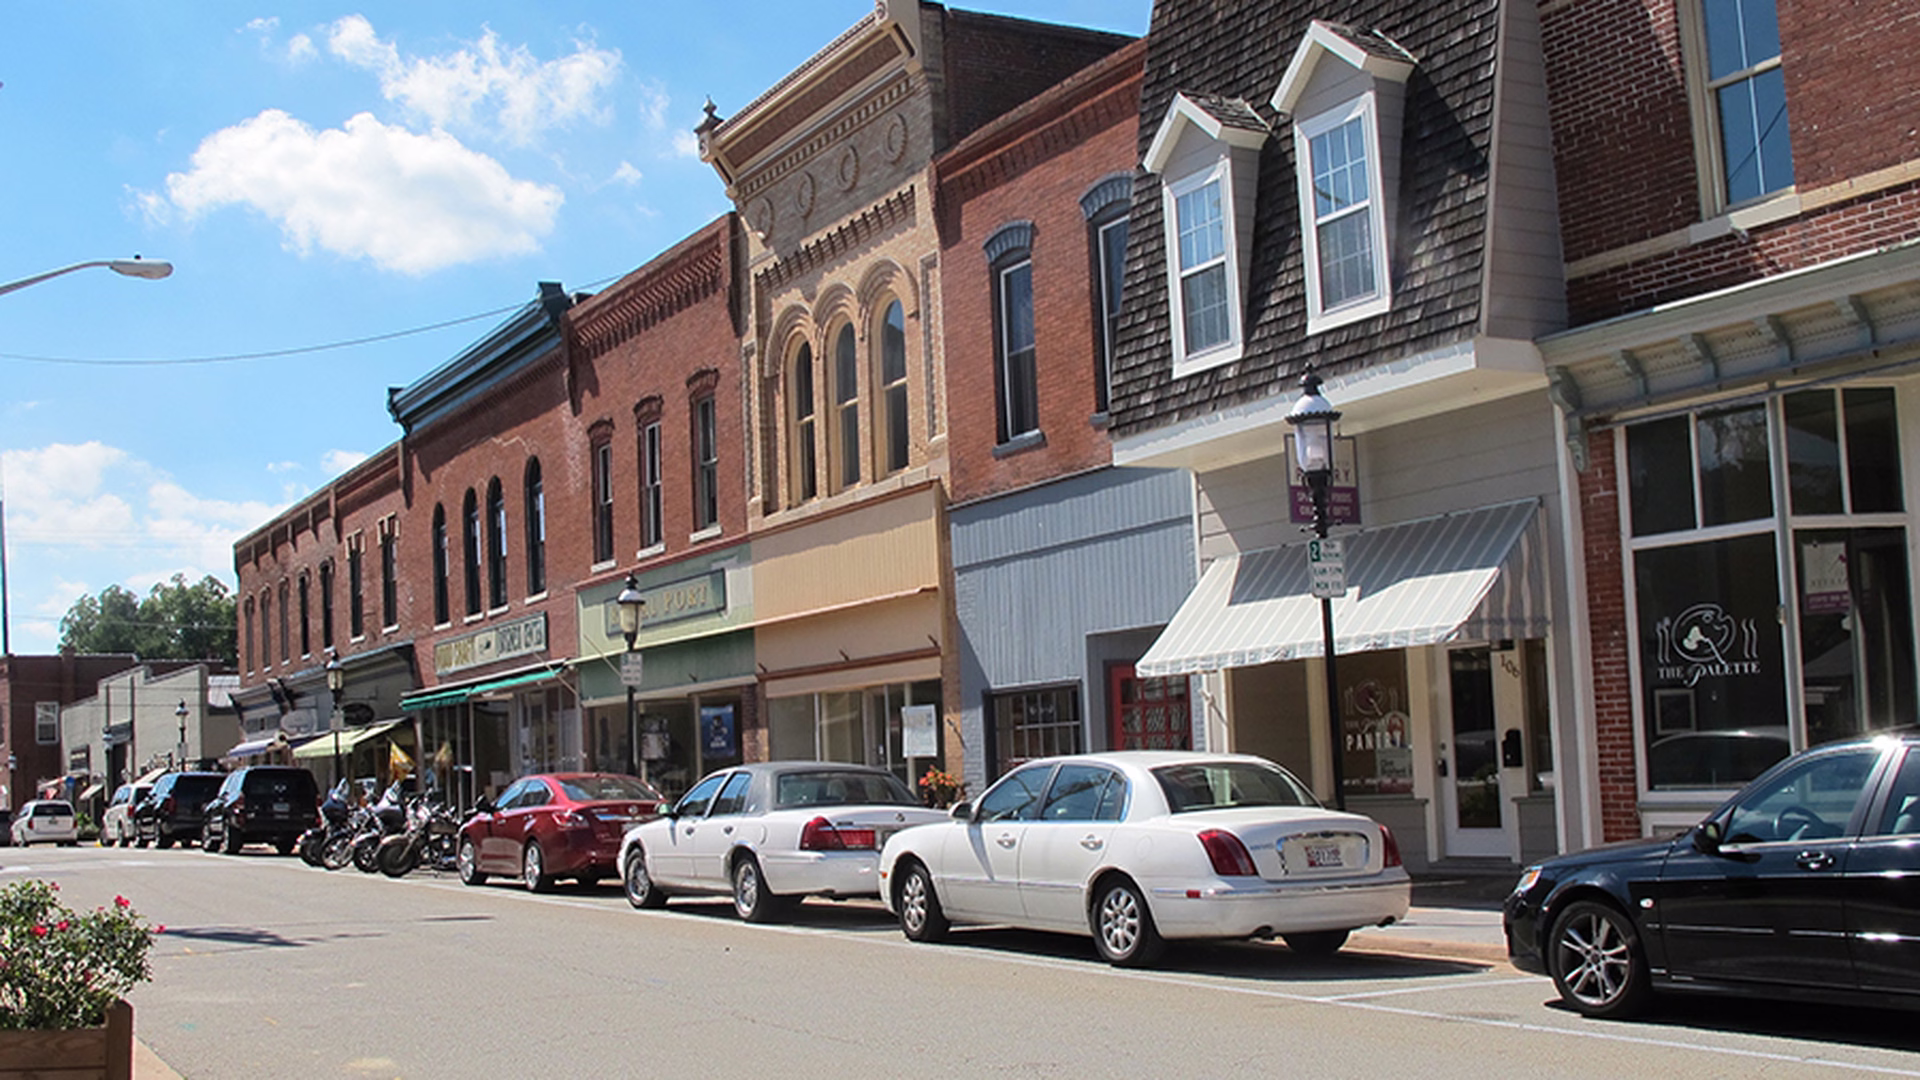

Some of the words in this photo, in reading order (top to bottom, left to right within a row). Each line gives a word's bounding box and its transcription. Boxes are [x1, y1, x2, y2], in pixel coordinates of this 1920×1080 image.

[662, 582, 708, 614] PORT
[1658, 666, 1685, 679] THE
[1346, 731, 1402, 751] PANTRY
